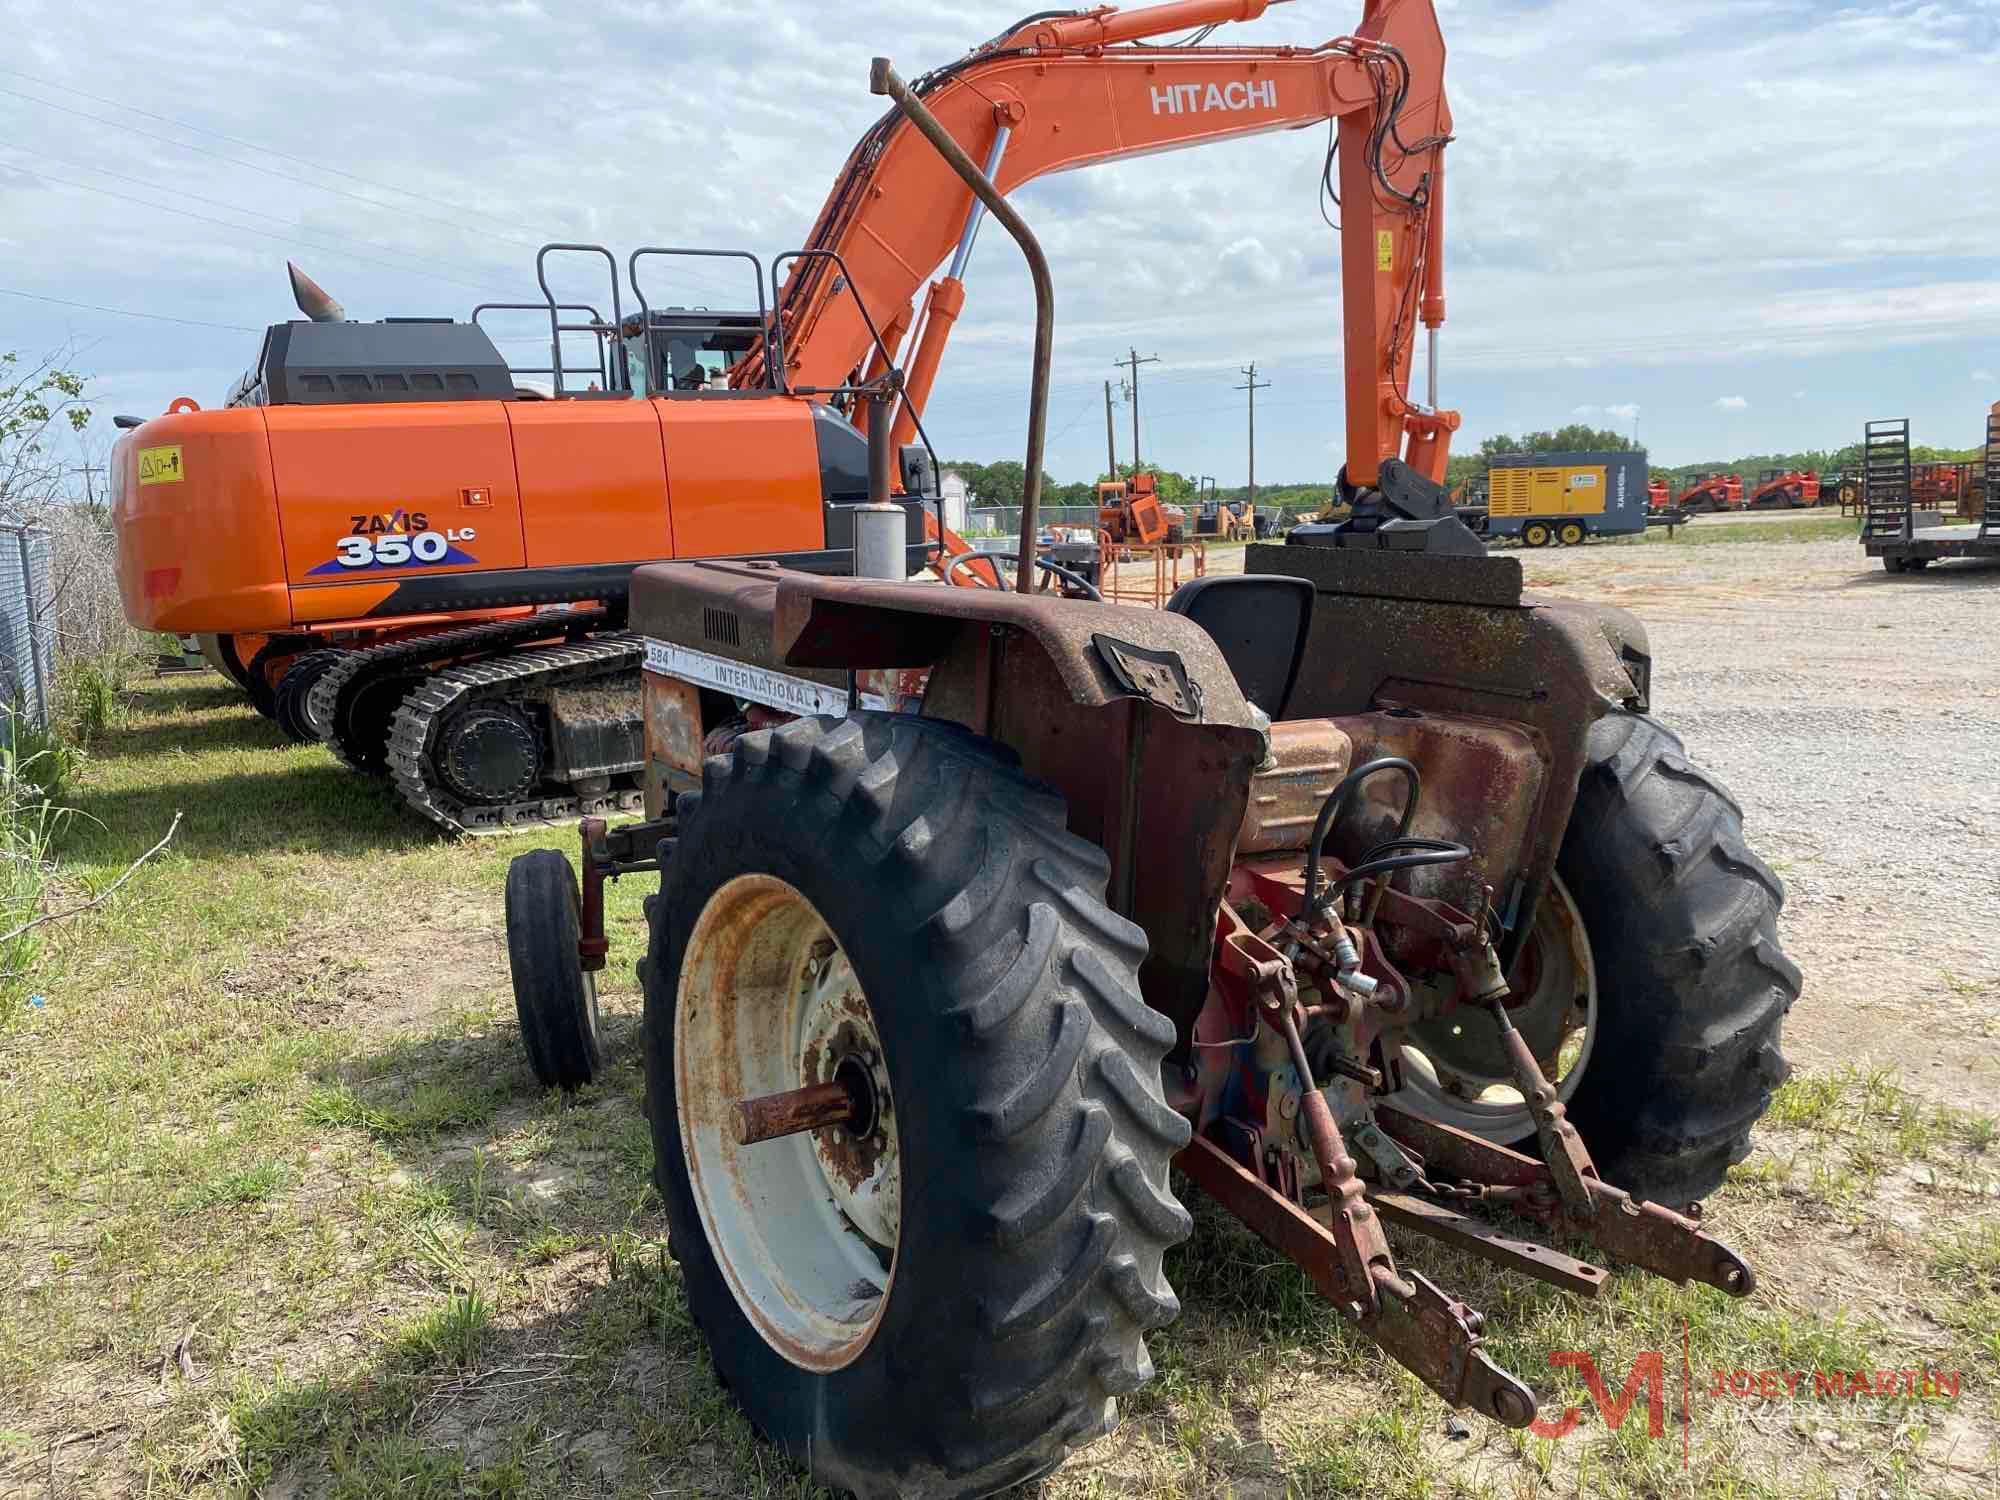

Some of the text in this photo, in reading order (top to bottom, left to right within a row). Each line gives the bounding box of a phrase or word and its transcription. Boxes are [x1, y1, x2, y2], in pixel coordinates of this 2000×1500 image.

[1150, 79, 1278, 115] HITACHI
[350, 509, 429, 535] ZAXIS
[650, 646, 811, 706] 584 INTERNATIONAL
